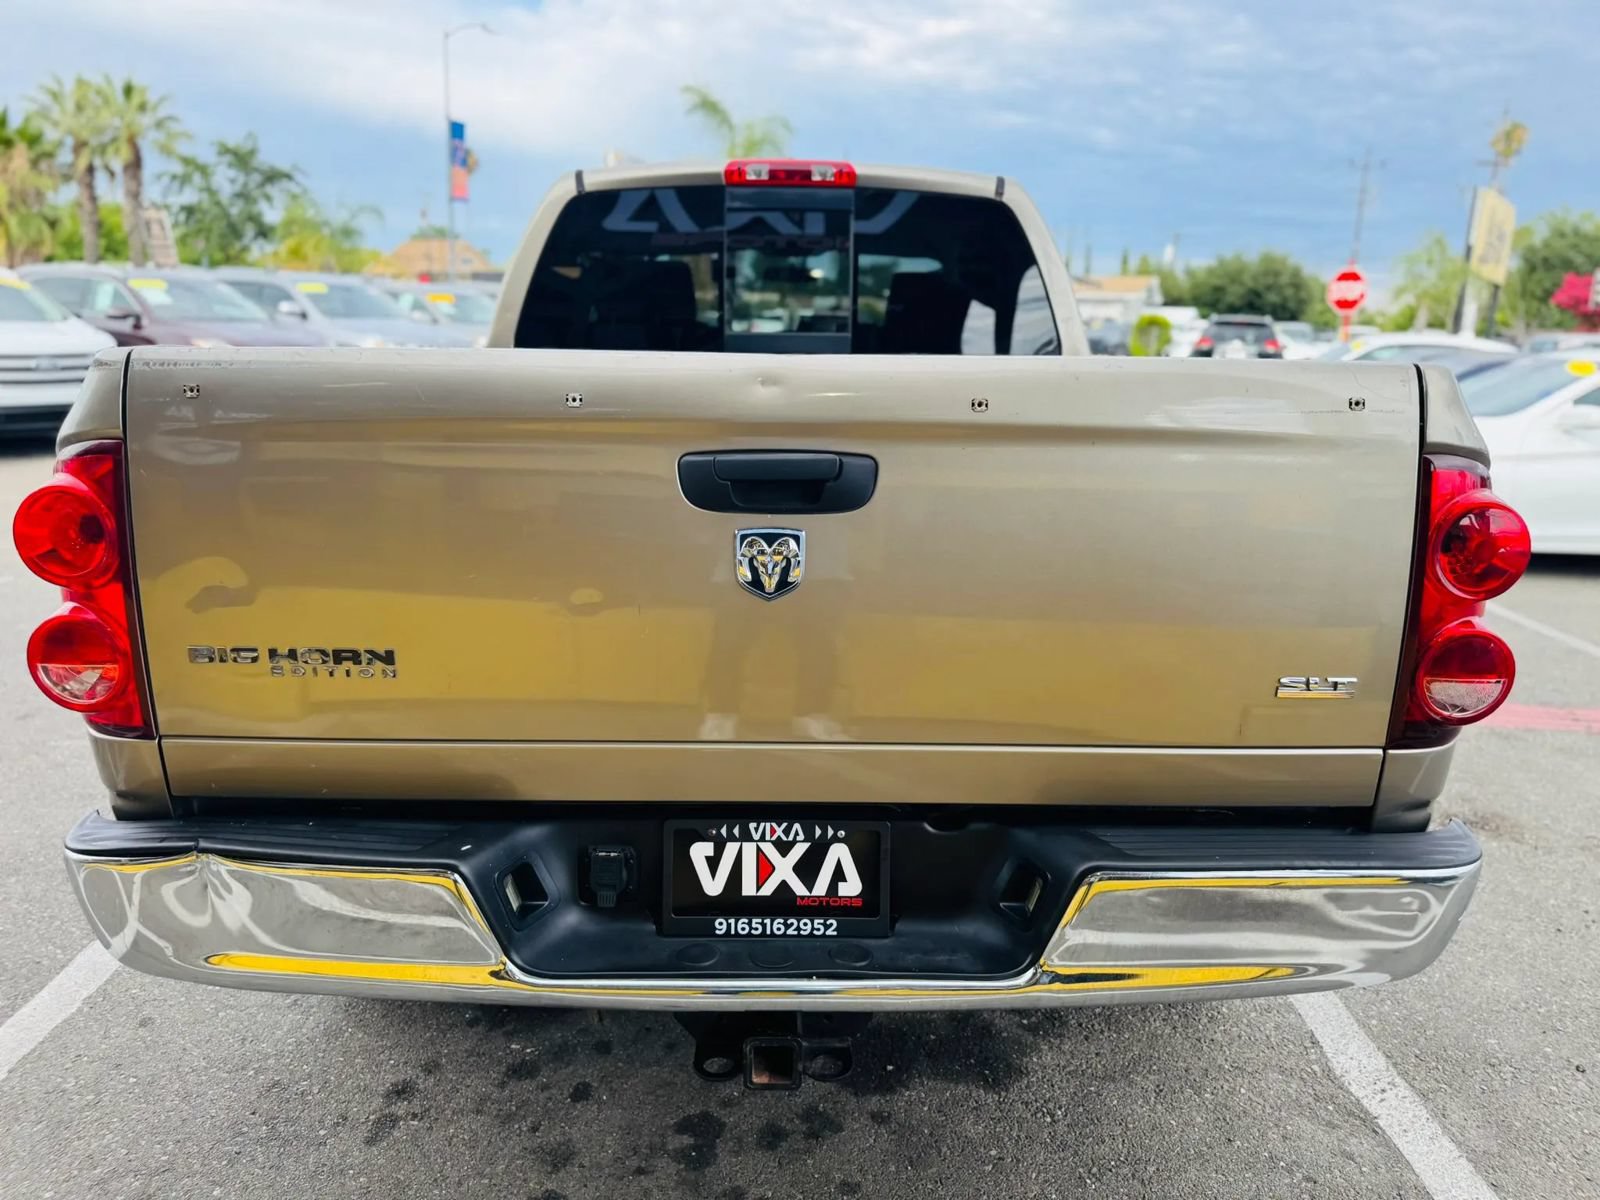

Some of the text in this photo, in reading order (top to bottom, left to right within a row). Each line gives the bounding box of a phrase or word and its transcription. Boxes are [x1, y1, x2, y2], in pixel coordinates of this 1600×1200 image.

[187, 645, 397, 666] BIG HORN
[270, 665, 397, 678] EDITION
[1277, 676, 1358, 694] SLT
[749, 822, 805, 841] VIXA
[689, 842, 863, 897] VIXA
[796, 897, 863, 907] MOTORS
[714, 918, 838, 936] 9165162952
